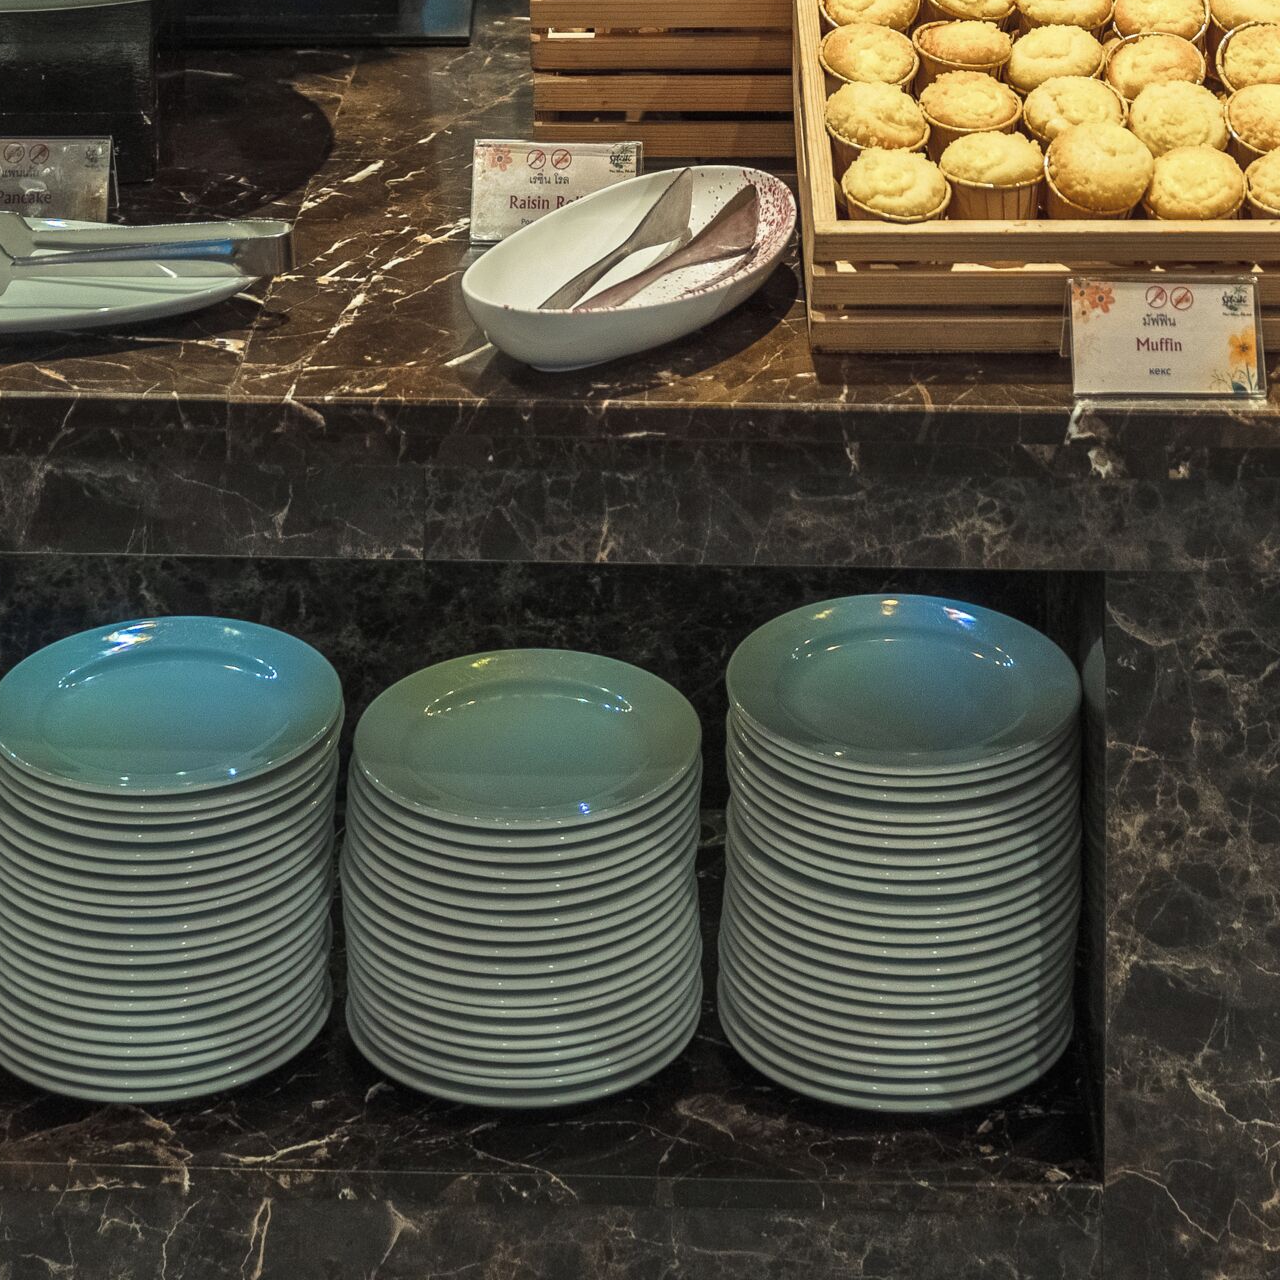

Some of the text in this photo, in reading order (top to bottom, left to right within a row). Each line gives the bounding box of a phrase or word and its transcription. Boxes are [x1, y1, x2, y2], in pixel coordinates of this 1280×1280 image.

[509, 195, 550, 210] Raisin
[1136, 337, 1183, 352] Muffin
[1149, 367, 1172, 376] кекс
